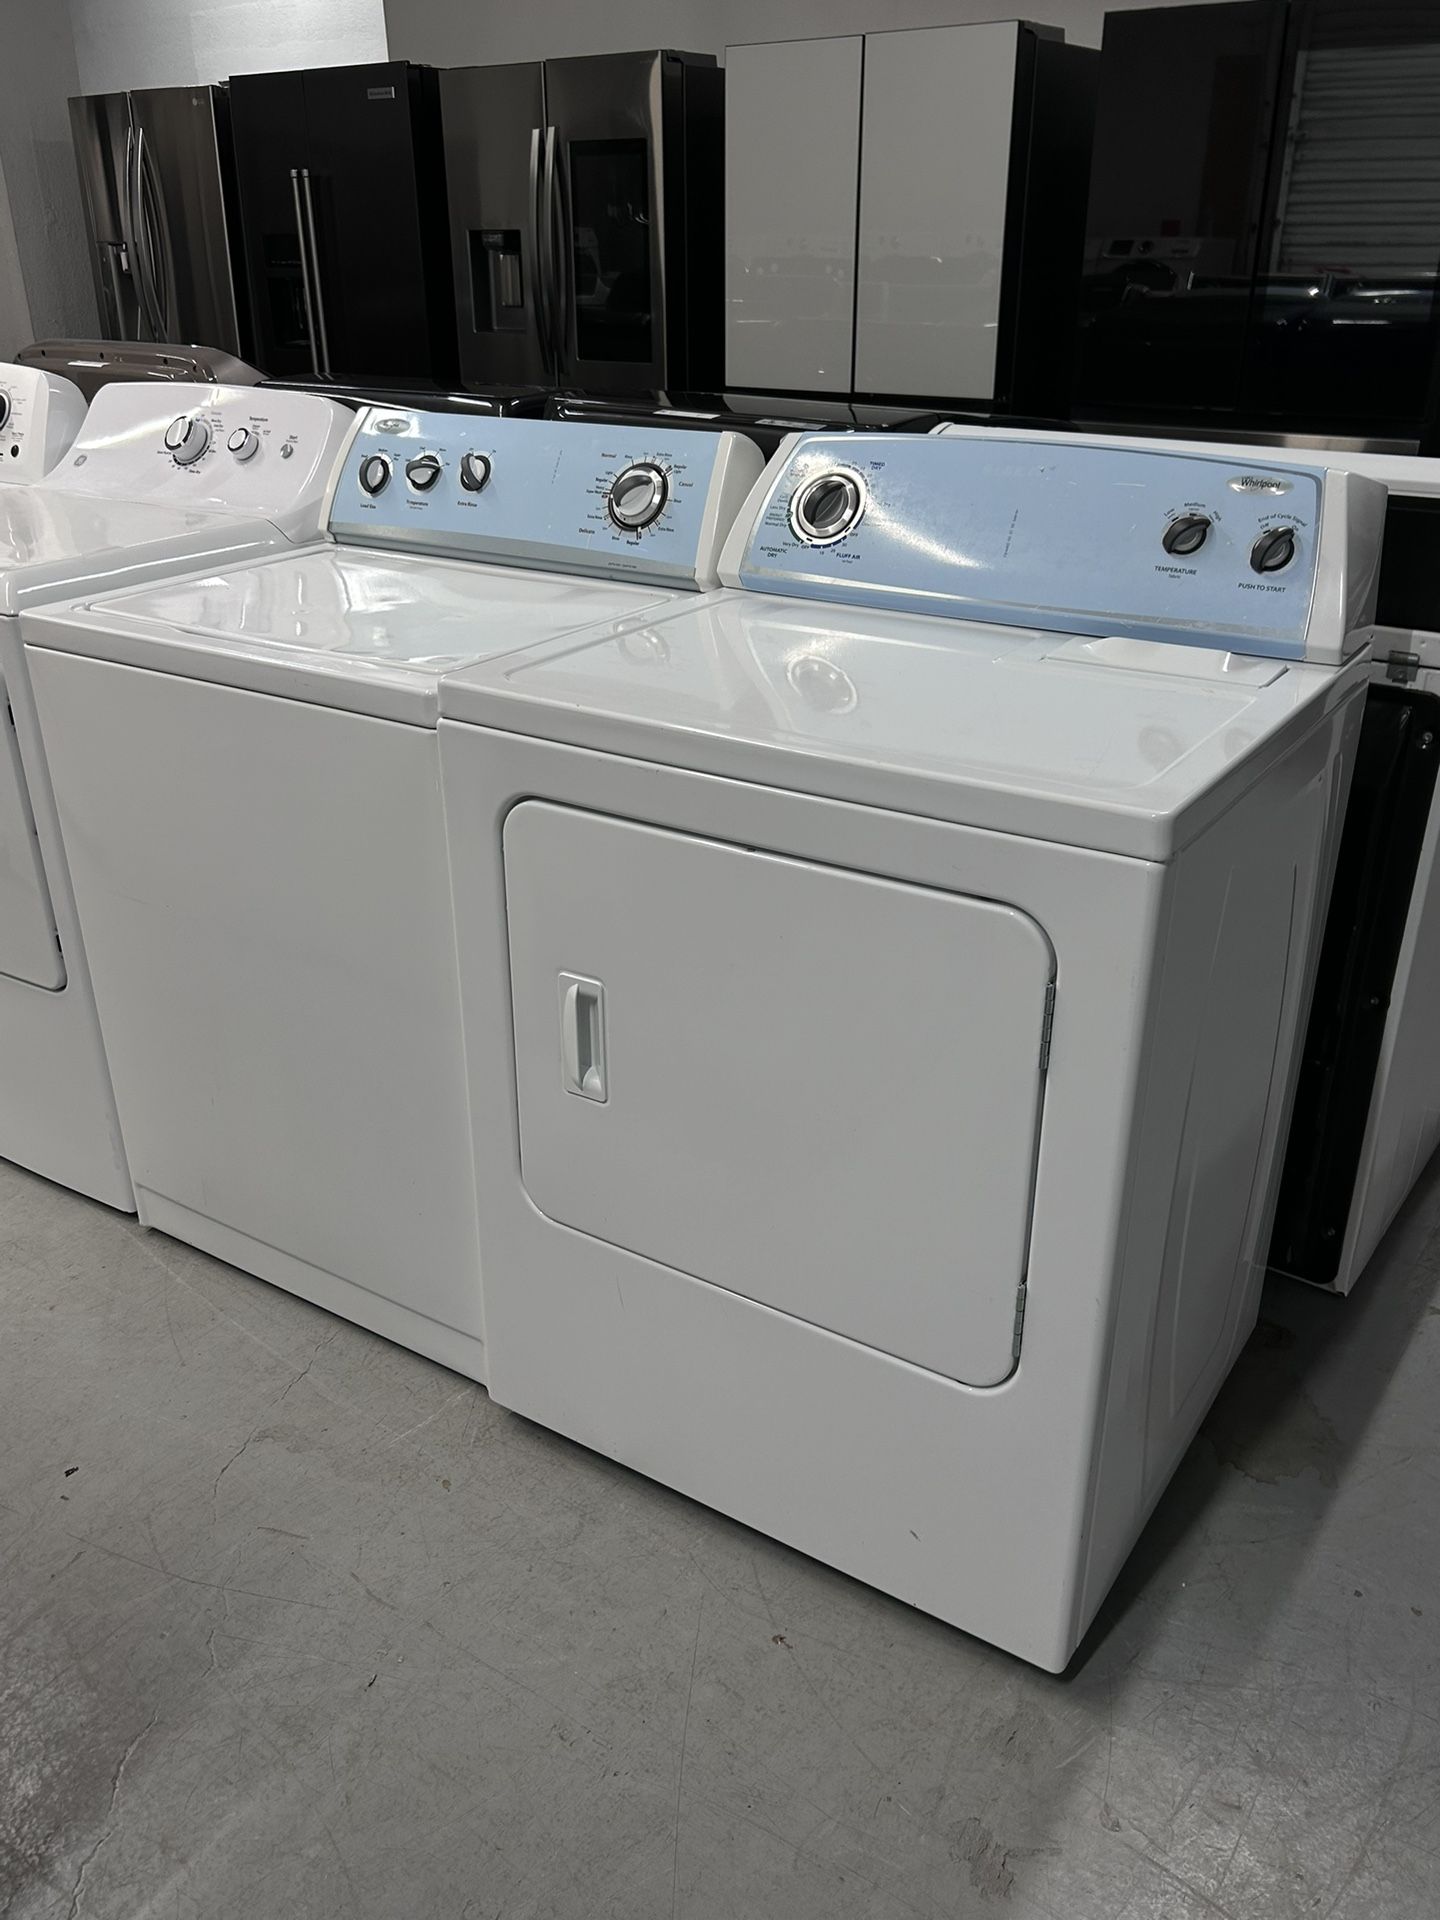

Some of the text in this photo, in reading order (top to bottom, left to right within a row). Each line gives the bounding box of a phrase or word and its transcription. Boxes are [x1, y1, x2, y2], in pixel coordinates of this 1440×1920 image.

[1241, 476, 1281, 489] Whirlpool
[1257, 515, 1269, 523] End
[1292, 515, 1308, 527] Signal
[760, 546, 788, 554] AUTOMATIC
[1155, 565, 1197, 575] TEMPERATURE
[1238, 582, 1256, 590] PUSH
[1265, 585, 1286, 593] START
